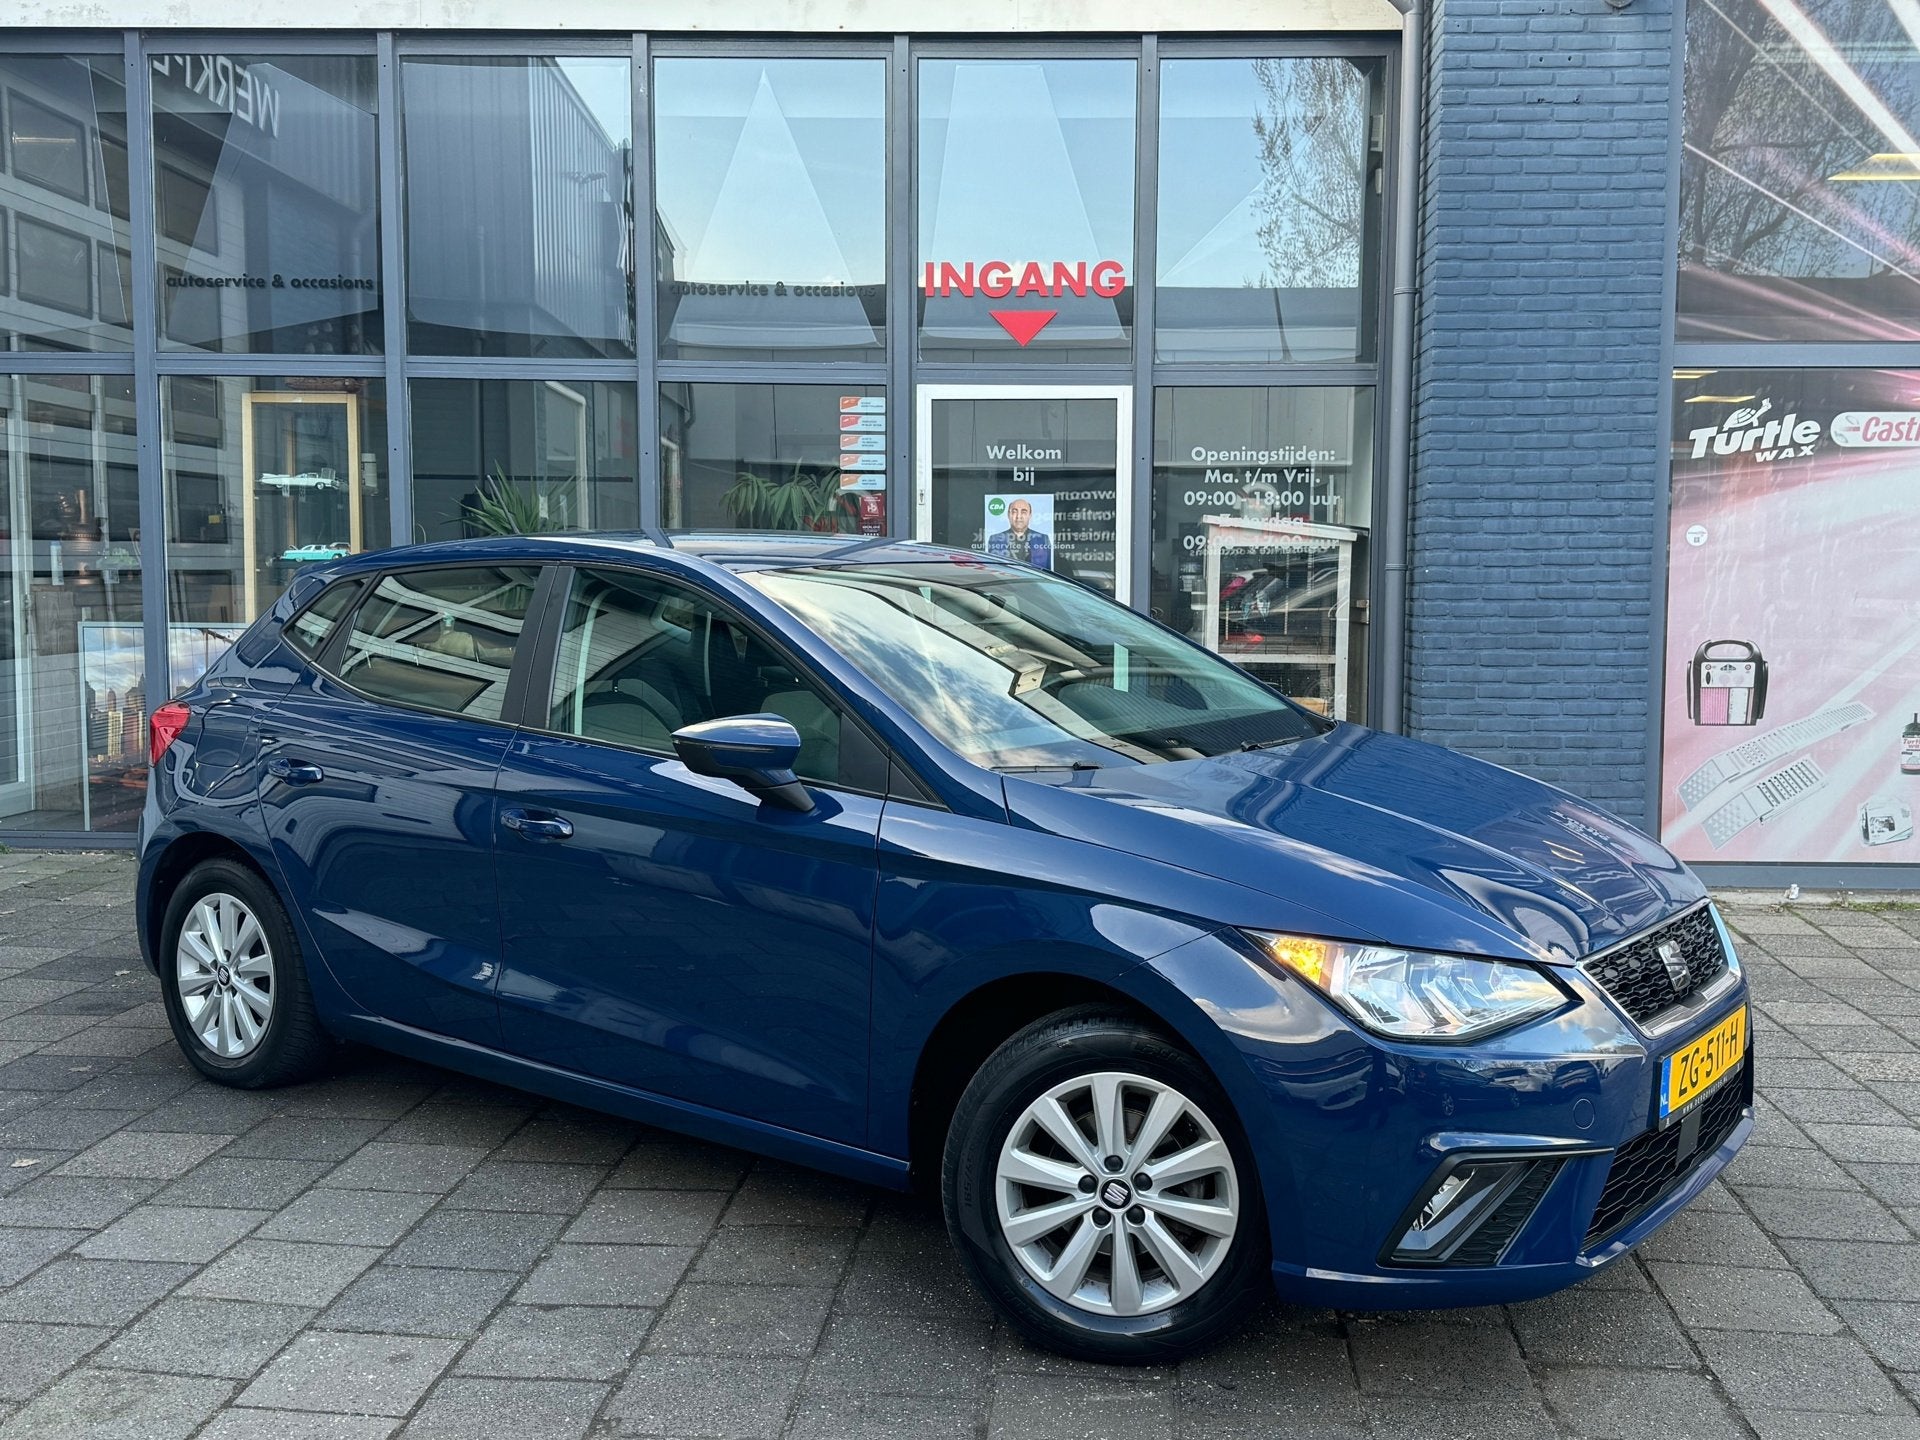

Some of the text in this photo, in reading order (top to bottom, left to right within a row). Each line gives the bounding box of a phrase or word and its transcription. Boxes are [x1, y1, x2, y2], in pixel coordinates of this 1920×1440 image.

[166, 273, 374, 291] autoservice & occasions
[669, 280, 876, 297] autoservice & occasions
[924, 260, 1126, 298] INGANG
[1689, 413, 1821, 463] Turtle WAX
[986, 444, 1062, 460] Welkom
[1191, 445, 1336, 465] Openingstijden:
[1013, 466, 1035, 486] bij
[1204, 468, 1321, 487] Ma. t/m Vrij.
[989, 503, 1005, 511] CDA
[1183, 490, 1237, 506] 09:00
[1254, 490, 1304, 506] 18:00
[1310, 493, 1341, 506] uur
[1219, 512, 1304, 531] Zterdag
[1678, 1017, 1739, 1098] ZG-511-H
[1660, 1092, 1669, 1107] NL
